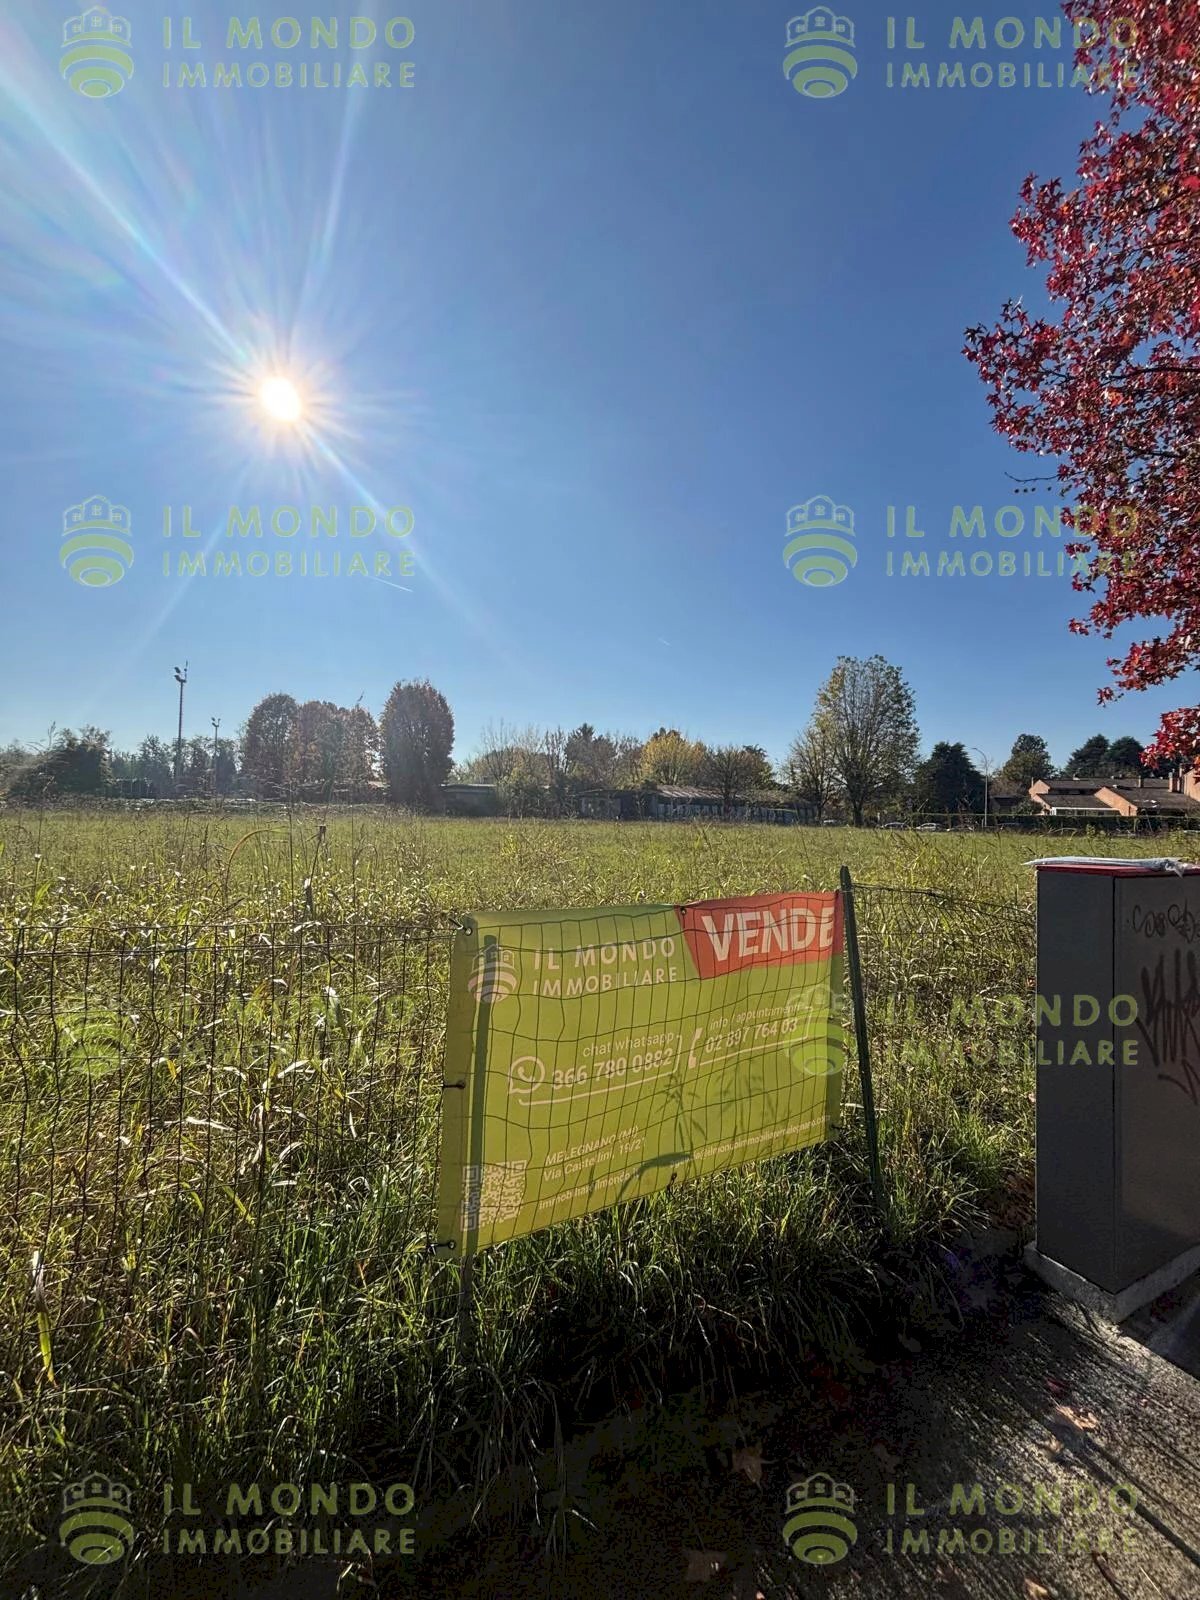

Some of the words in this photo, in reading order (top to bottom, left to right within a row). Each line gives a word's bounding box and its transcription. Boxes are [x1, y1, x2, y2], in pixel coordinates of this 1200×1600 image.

[534, 947, 560, 971] IL
[574, 936, 675, 968] MONDO
[533, 966, 678, 996] IMMOBILIARE
[705, 1036, 723, 1054] 02
[727, 1026, 751, 1047] 897
[754, 1020, 778, 1041] 764
[781, 1018, 799, 1035] 03
[710, 1016, 728, 1031] info
[582, 1041, 612, 1058] chat
[615, 1032, 675, 1051] whatsapp
[552, 1064, 588, 1090] 366
[593, 1056, 627, 1082] 780
[632, 1047, 674, 1074] 0882
[543, 1168, 562, 1182] Via
[564, 1149, 616, 1175] Castelini,
[545, 1133, 617, 1167] MELEGNANO
